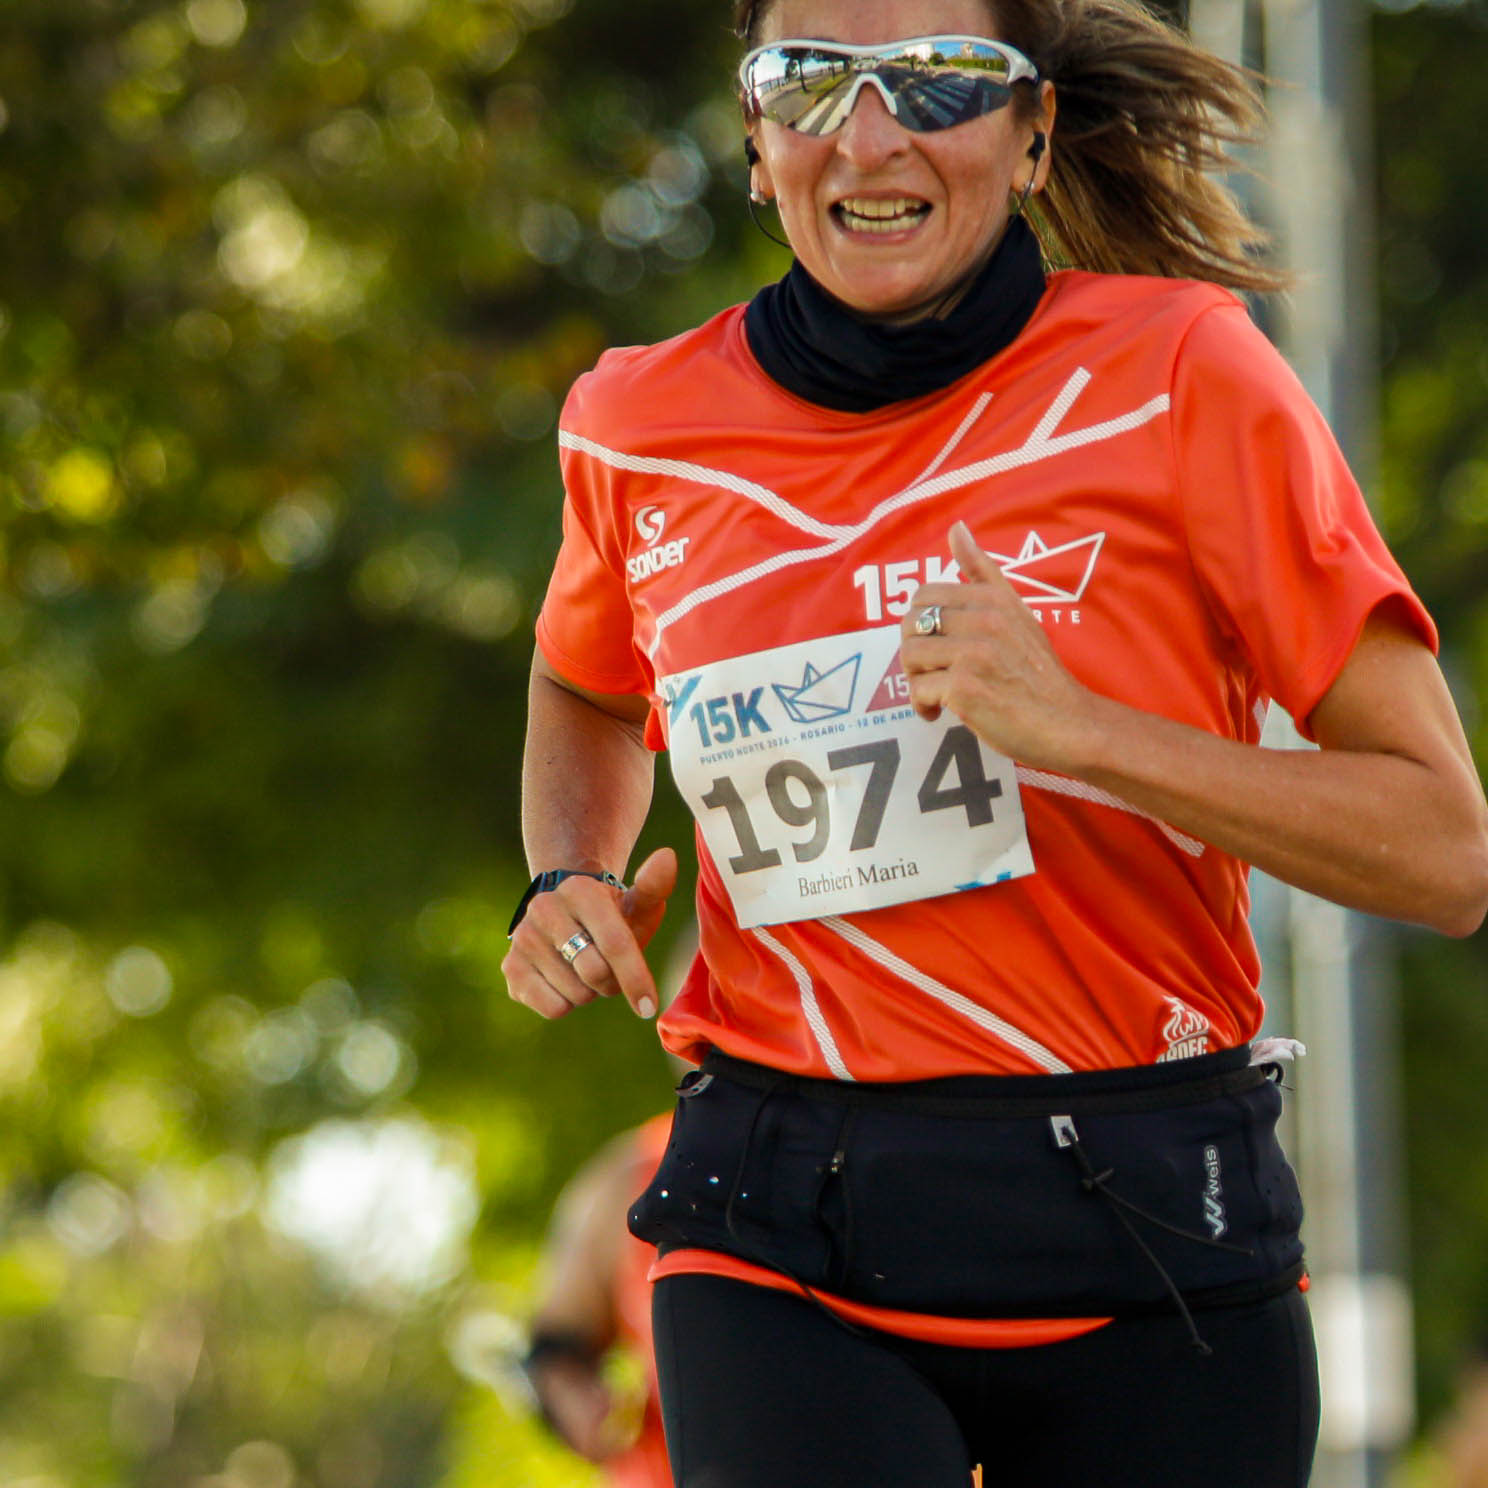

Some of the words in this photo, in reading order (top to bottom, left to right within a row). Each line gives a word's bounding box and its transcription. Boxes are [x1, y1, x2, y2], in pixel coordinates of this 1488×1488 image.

[690, 687, 772, 748] 15K
[800, 724, 846, 742] ROSARIO
[873, 714, 887, 725] DE
[701, 724, 1003, 875] 1974
[798, 867, 854, 898] Barbieri
[857, 858, 920, 887] Maria
